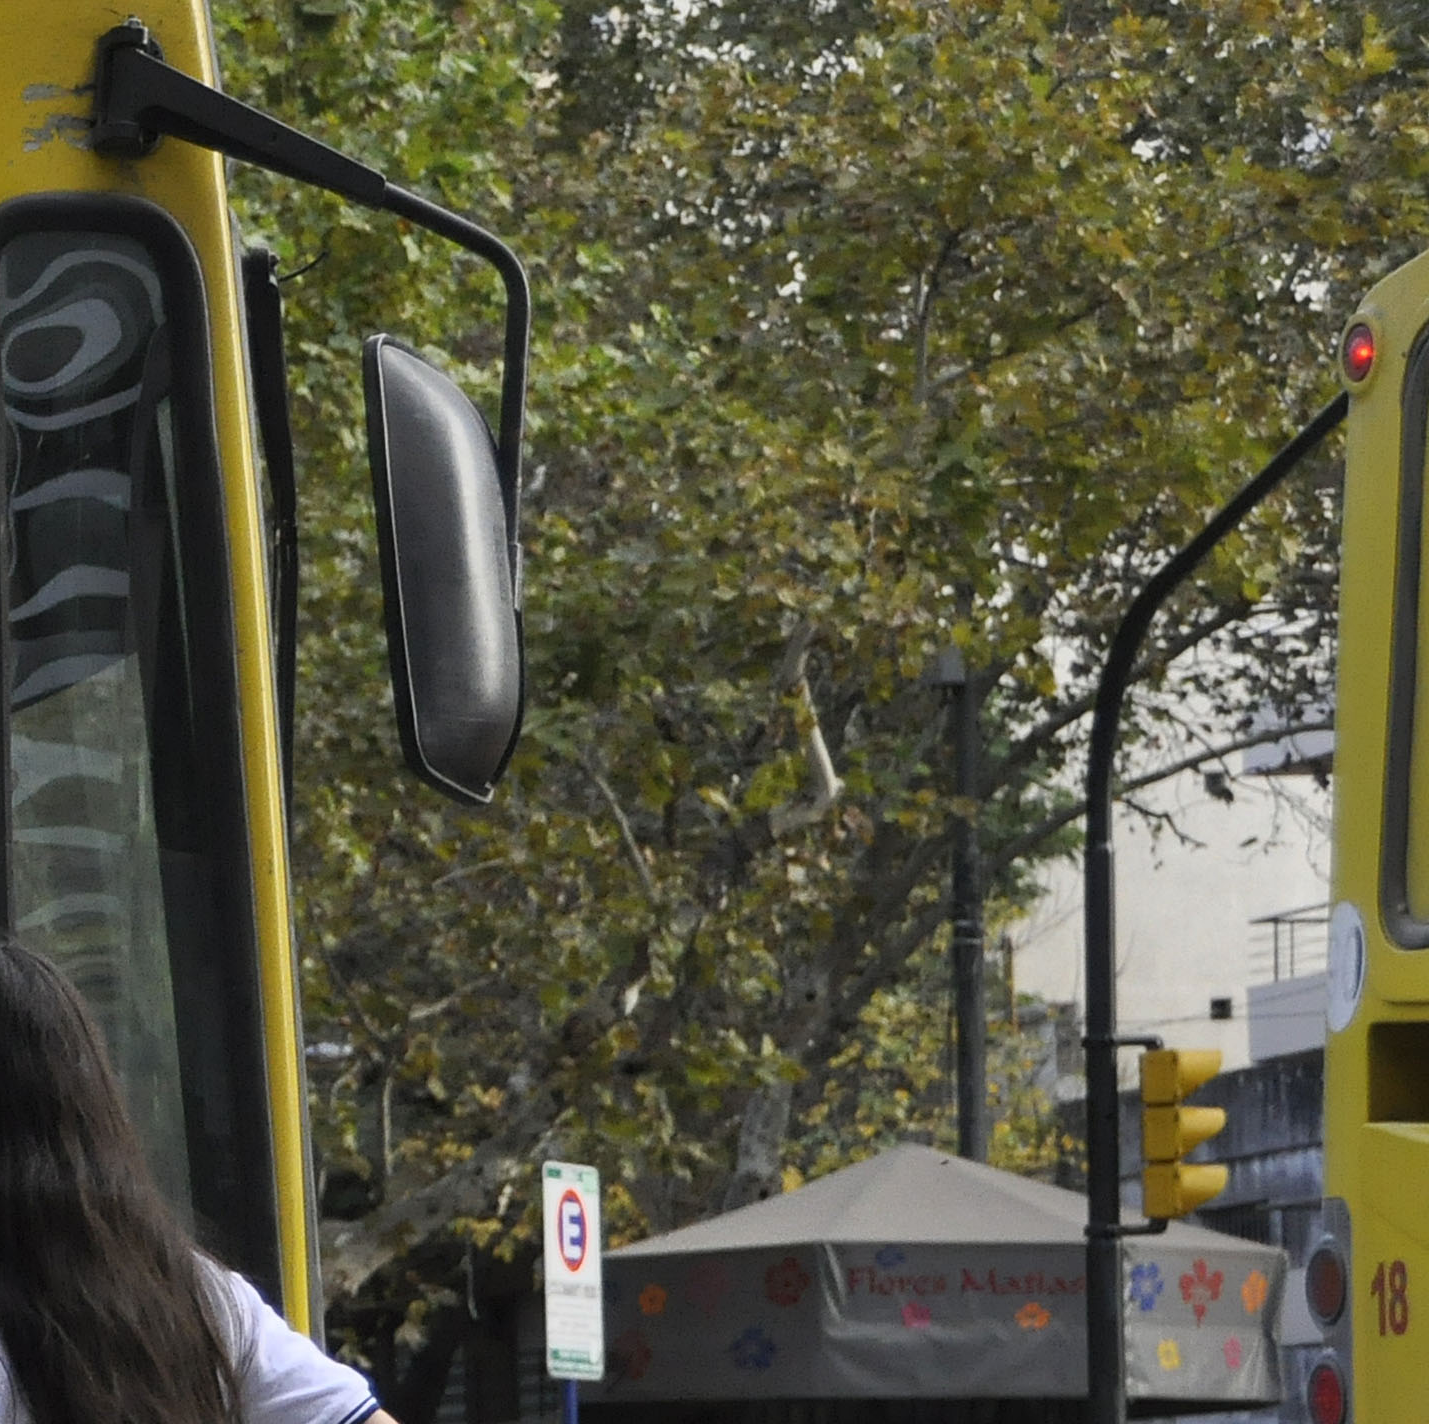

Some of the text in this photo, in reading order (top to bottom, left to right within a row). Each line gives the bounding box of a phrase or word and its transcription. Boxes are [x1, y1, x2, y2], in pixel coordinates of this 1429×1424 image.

[561, 1201, 583, 1261] E
[847, 1266, 948, 1295] Flores
[1371, 1260, 1410, 1337] 18
